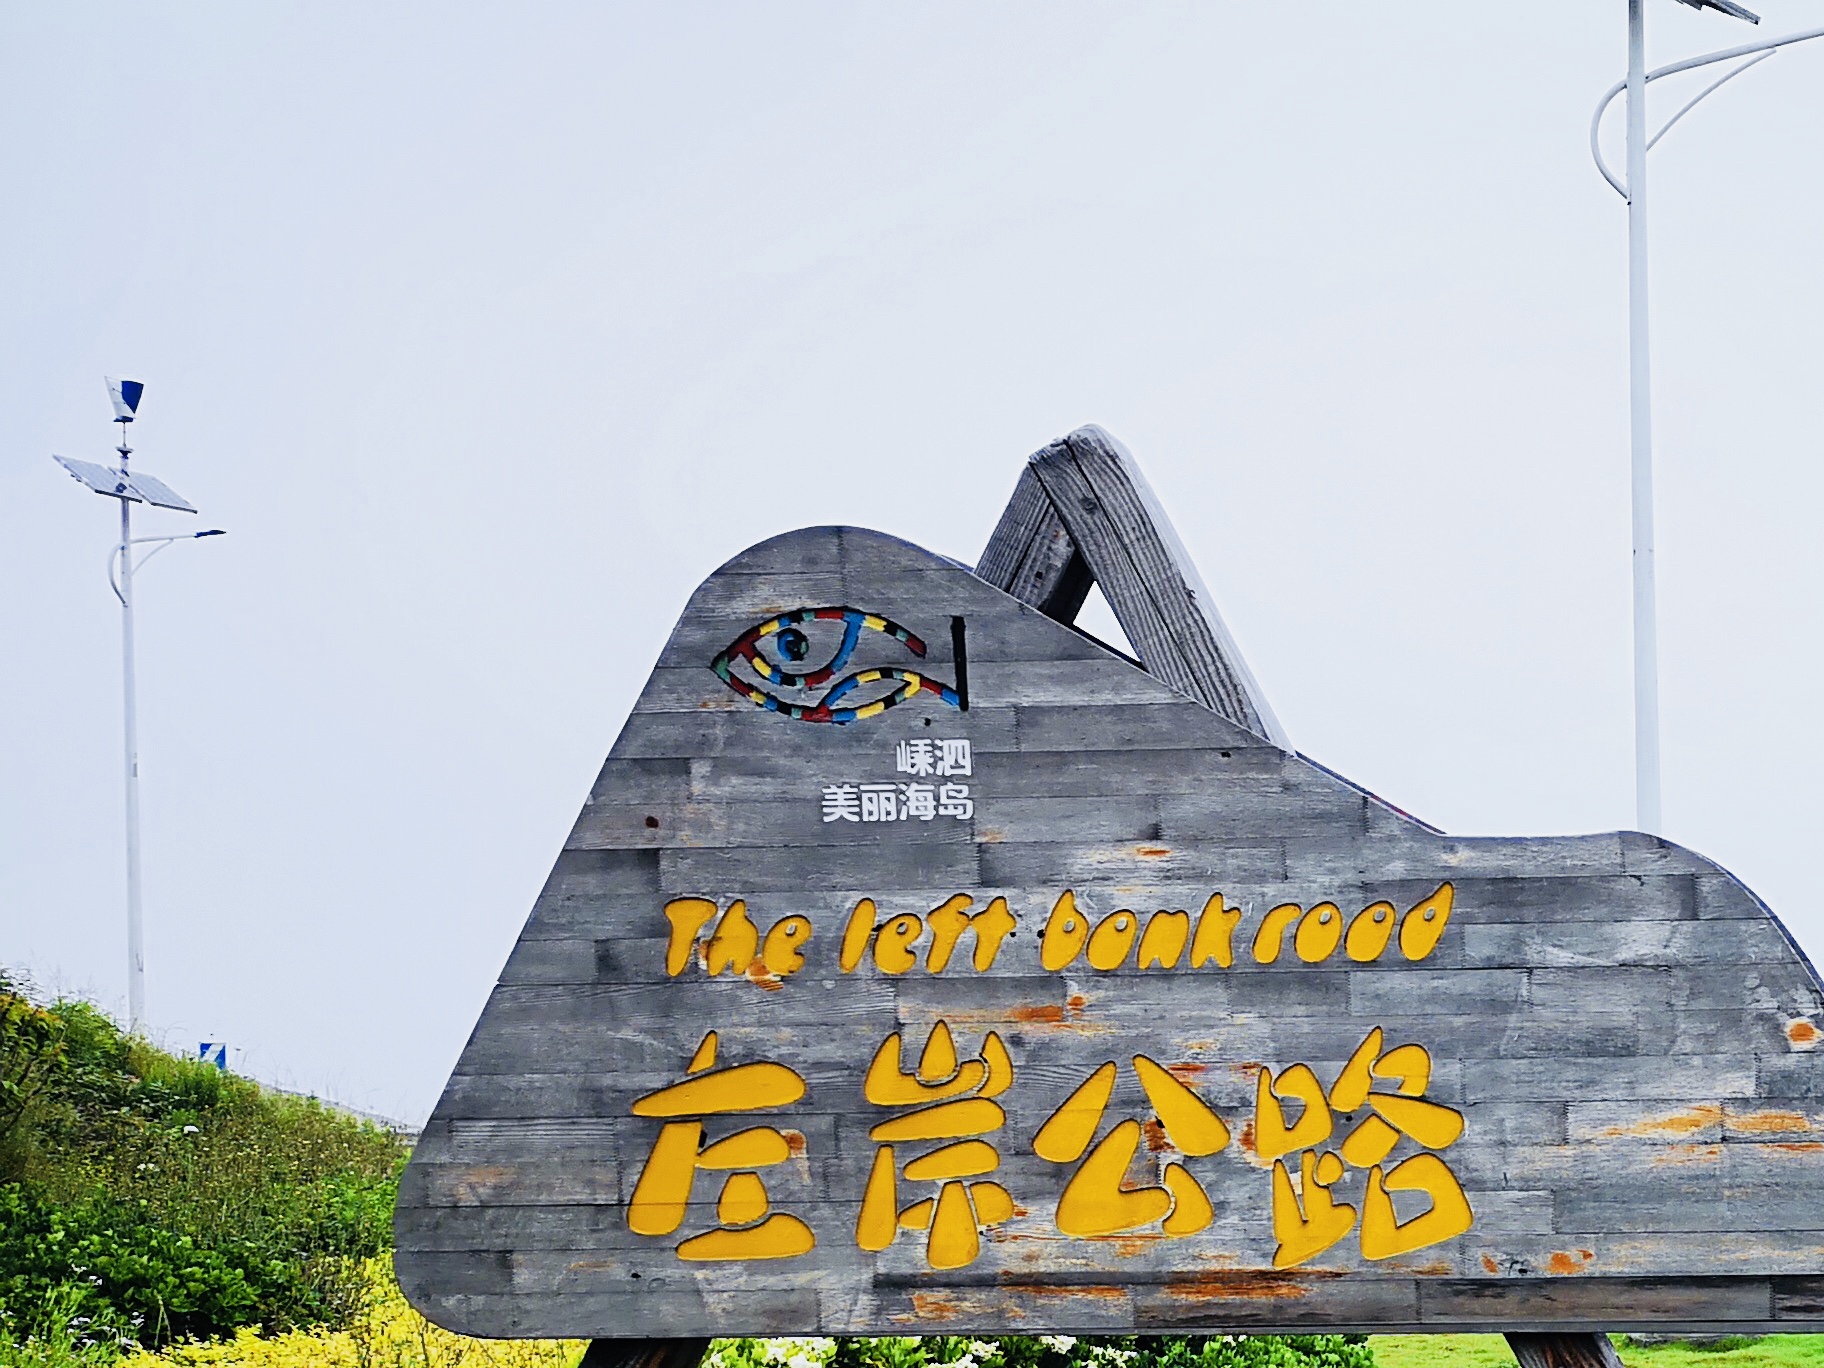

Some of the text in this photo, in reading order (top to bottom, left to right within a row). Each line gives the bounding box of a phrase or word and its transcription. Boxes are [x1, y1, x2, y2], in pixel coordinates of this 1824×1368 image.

[896, 738, 972, 776] 嵊泗
[821, 782, 974, 822] 美丽海岛
[663, 896, 812, 977] The
[839, 892, 1017, 975] left
[626, 1018, 1473, 1270] 左岸公路
